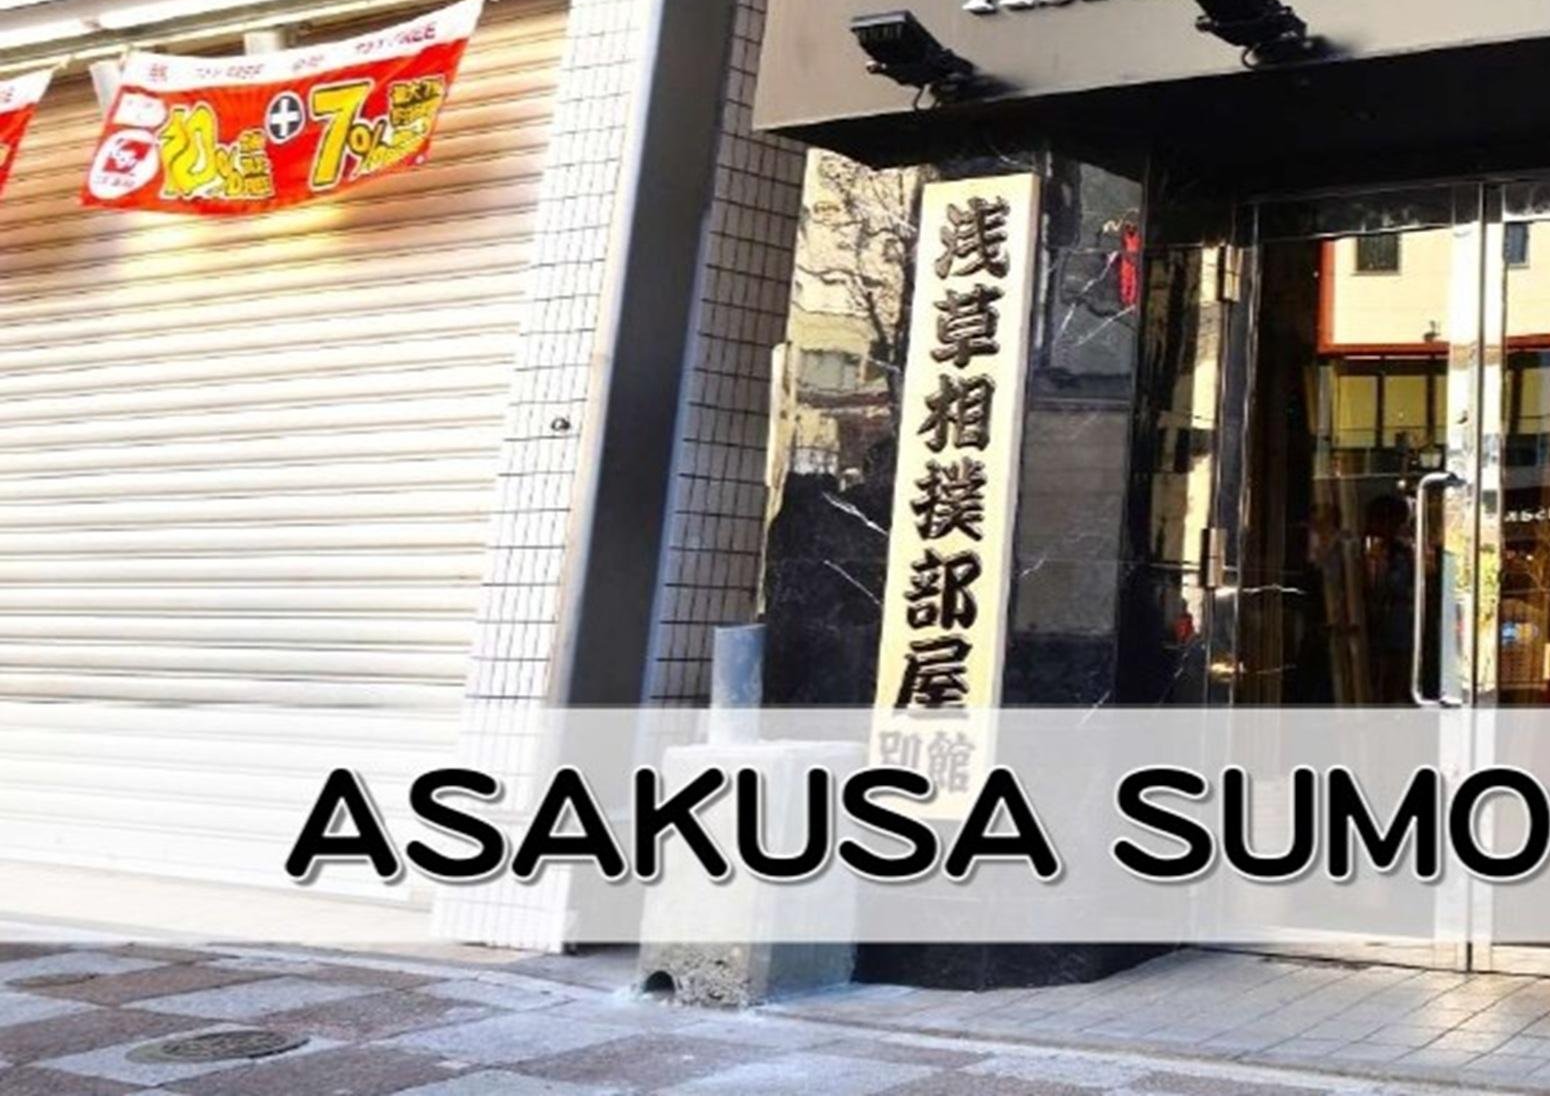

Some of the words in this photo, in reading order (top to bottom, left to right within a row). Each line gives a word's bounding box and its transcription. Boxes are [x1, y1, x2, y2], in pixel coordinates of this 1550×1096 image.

[893, 195, 1011, 720] 浅草相撲部屋
